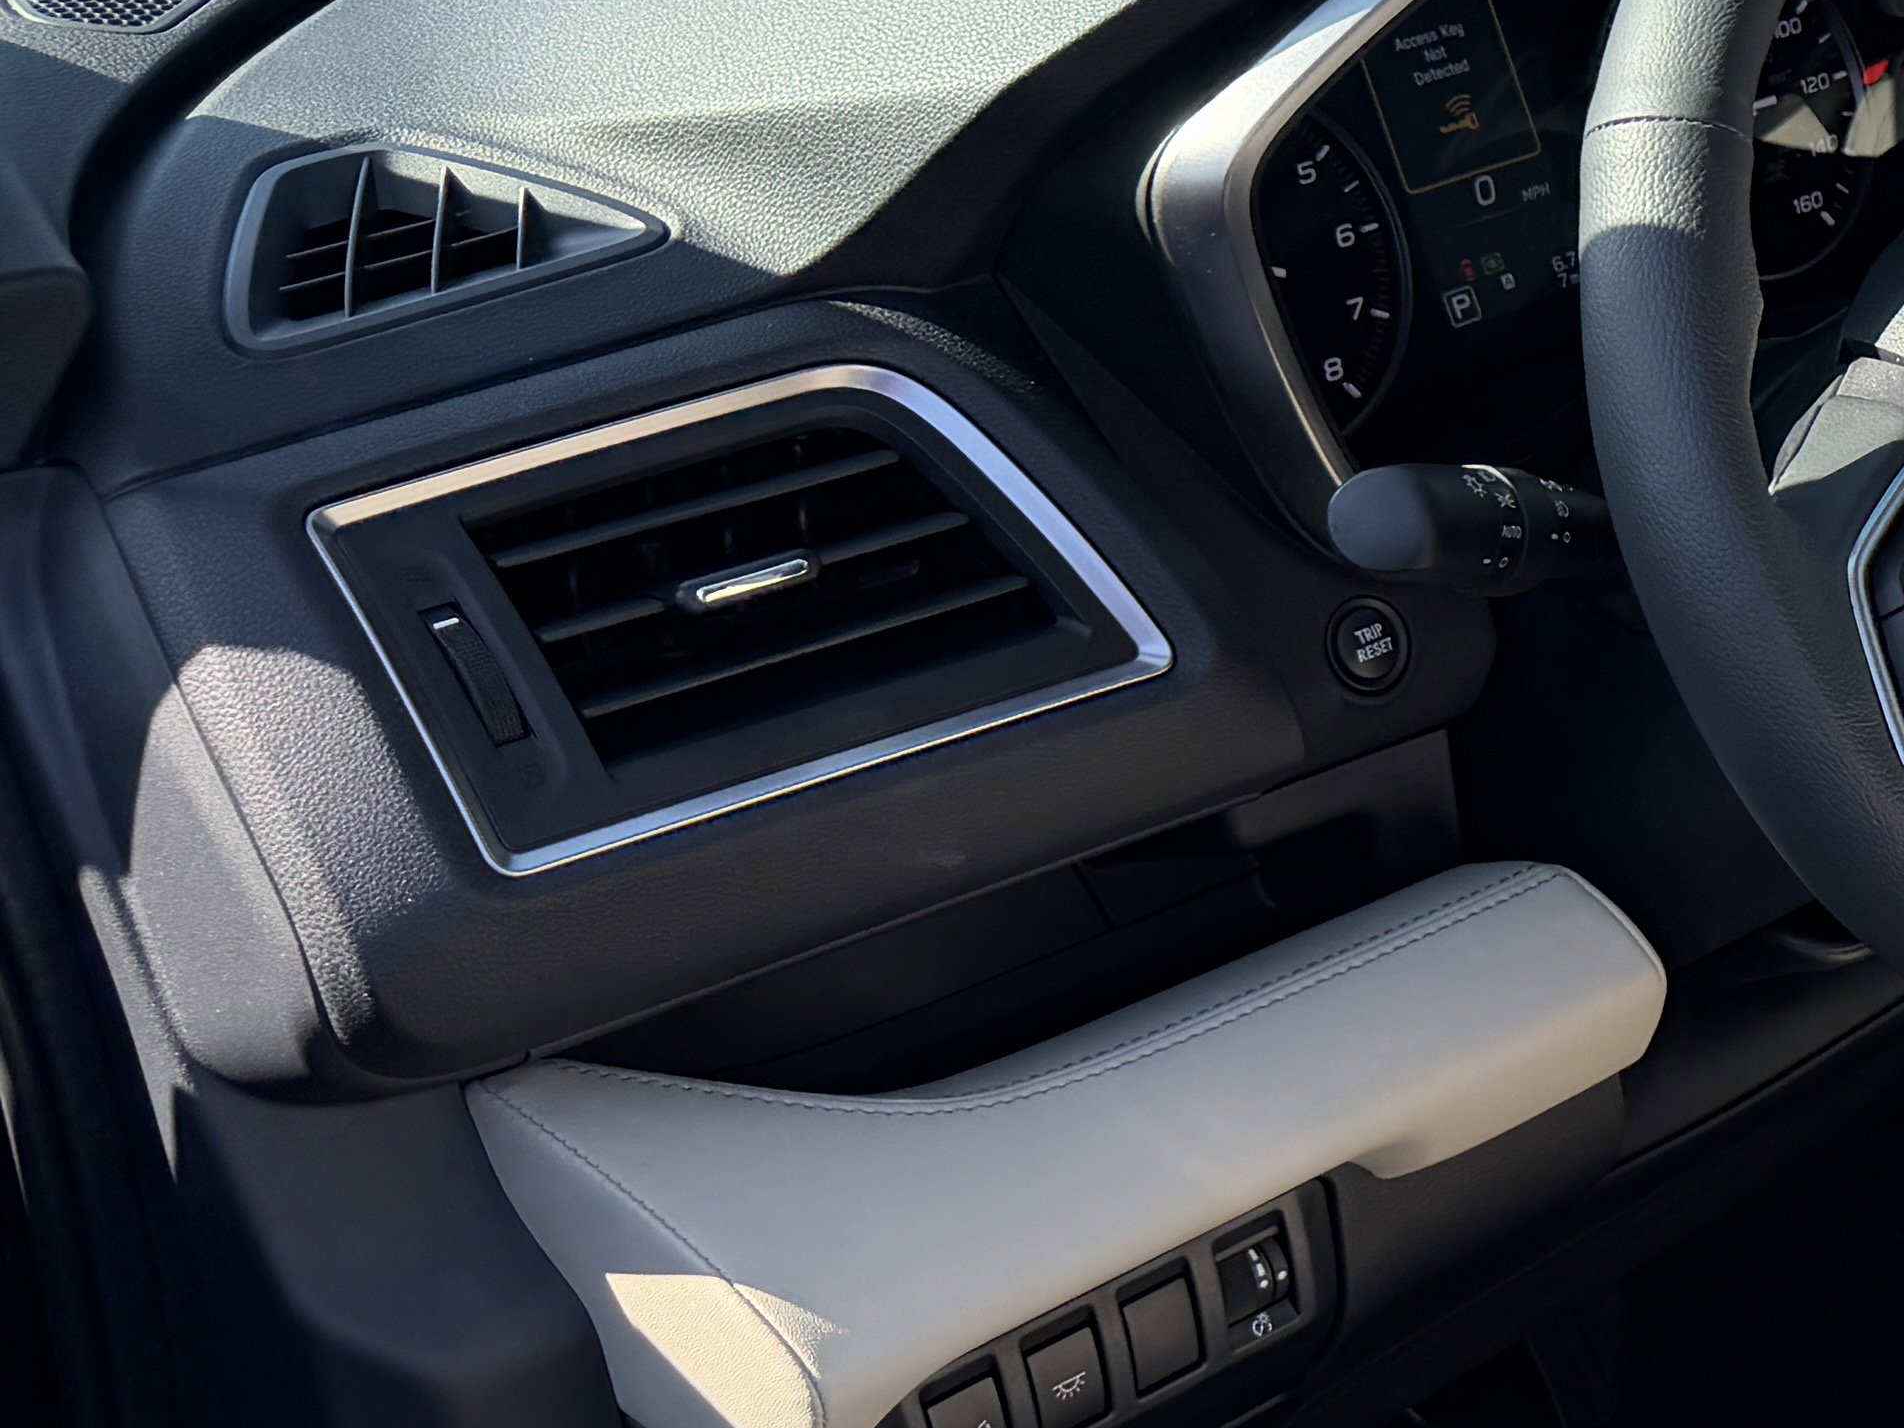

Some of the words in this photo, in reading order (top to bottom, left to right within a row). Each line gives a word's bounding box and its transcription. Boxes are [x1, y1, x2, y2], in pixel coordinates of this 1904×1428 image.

[1395, 30, 1438, 52] Access
[1439, 23, 1465, 38] Key
[1424, 46, 1448, 63] Not
[1413, 59, 1470, 86] Detected
[1800, 72, 1830, 94] 120
[1807, 134, 1839, 157] 140
[1296, 160, 1317, 185] 5
[1474, 174, 1496, 207] 0
[1521, 182, 1550, 203] MPH
[1793, 191, 1824, 214] 160
[1335, 224, 1356, 248] 6
[1346, 296, 1365, 321] 7
[1452, 292, 1472, 320] P
[1323, 356, 1345, 382] 8
[1502, 524, 1523, 540] AUTO
[1353, 622, 1383, 645] TRIP
[1357, 636, 1394, 663] RESET
